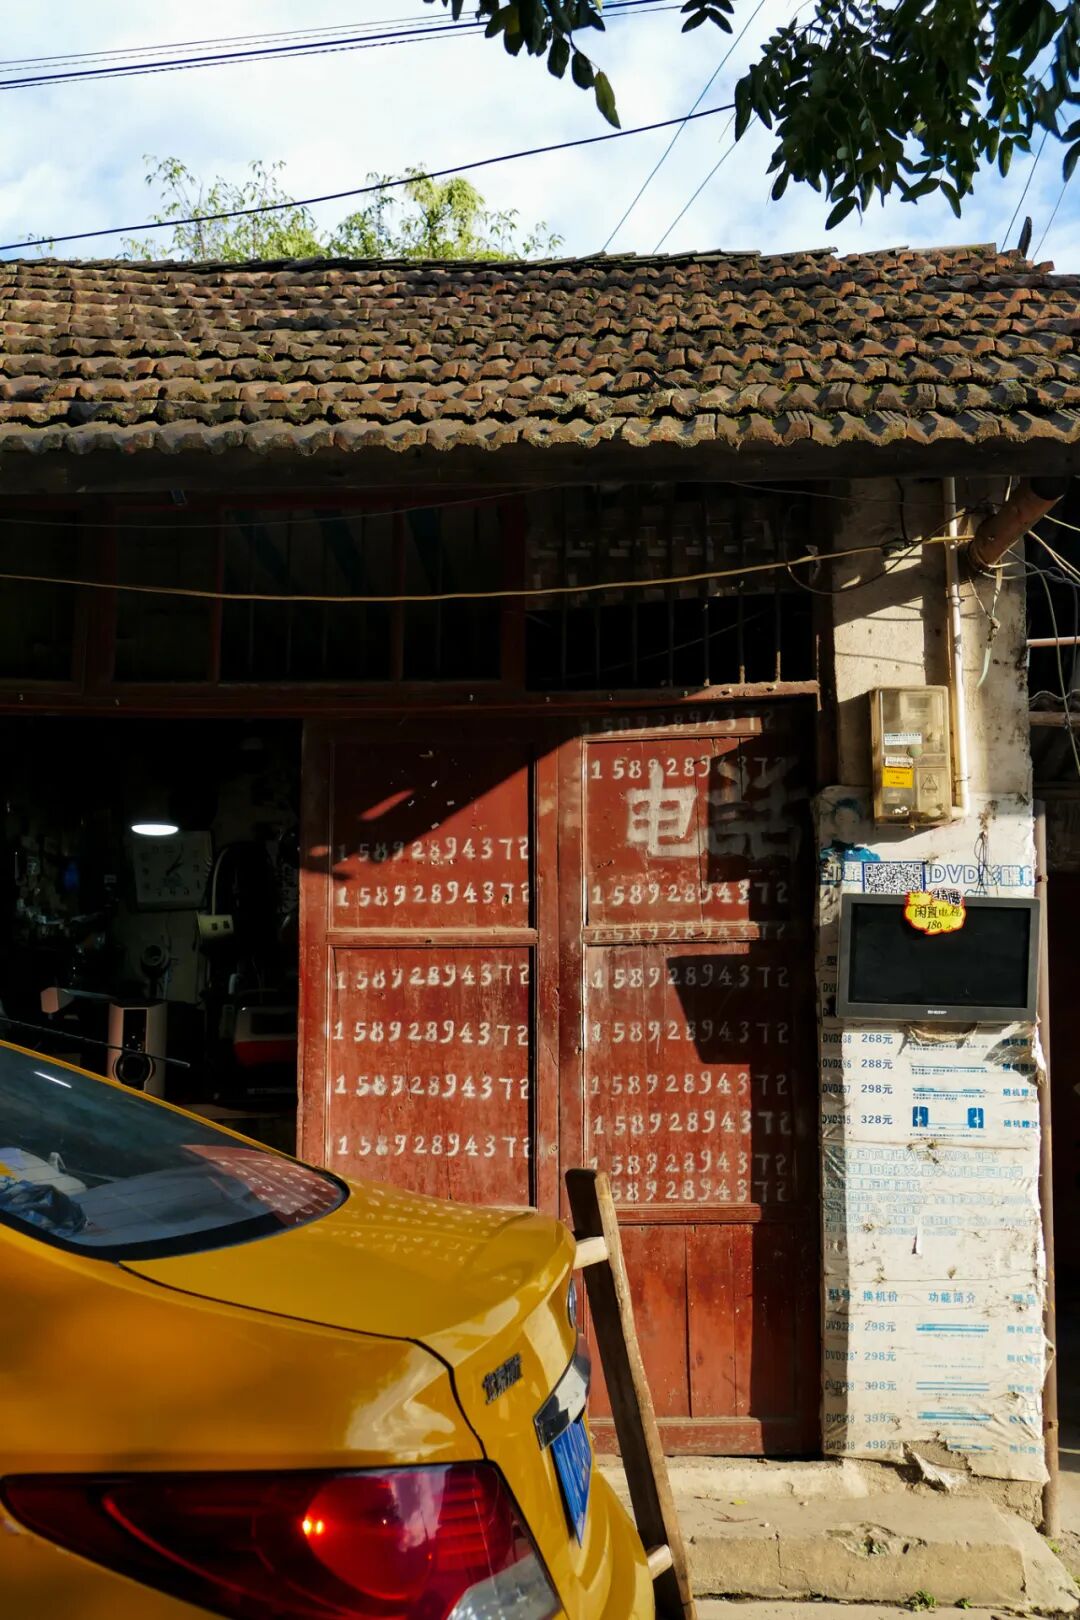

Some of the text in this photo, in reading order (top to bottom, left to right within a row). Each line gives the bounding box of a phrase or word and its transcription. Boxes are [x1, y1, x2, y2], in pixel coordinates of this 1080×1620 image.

[337, 881, 529, 907] 15892894372
[336, 964, 529, 989] 15892894372
[591, 964, 790, 988] 15892894372
[333, 1020, 528, 1046] 15892894372
[861, 1034, 893, 1044] 268元
[861, 1060, 893, 1070] 288元
[335, 1074, 529, 1099] 15892894372
[590, 1071, 789, 1096] 15892894372
[861, 1085, 893, 1094] 298元
[593, 1110, 792, 1135] 15892894372
[861, 1115, 893, 1125] 328元
[928, 1291, 976, 1304] 功能简介
[864, 1351, 896, 1361] 298元
